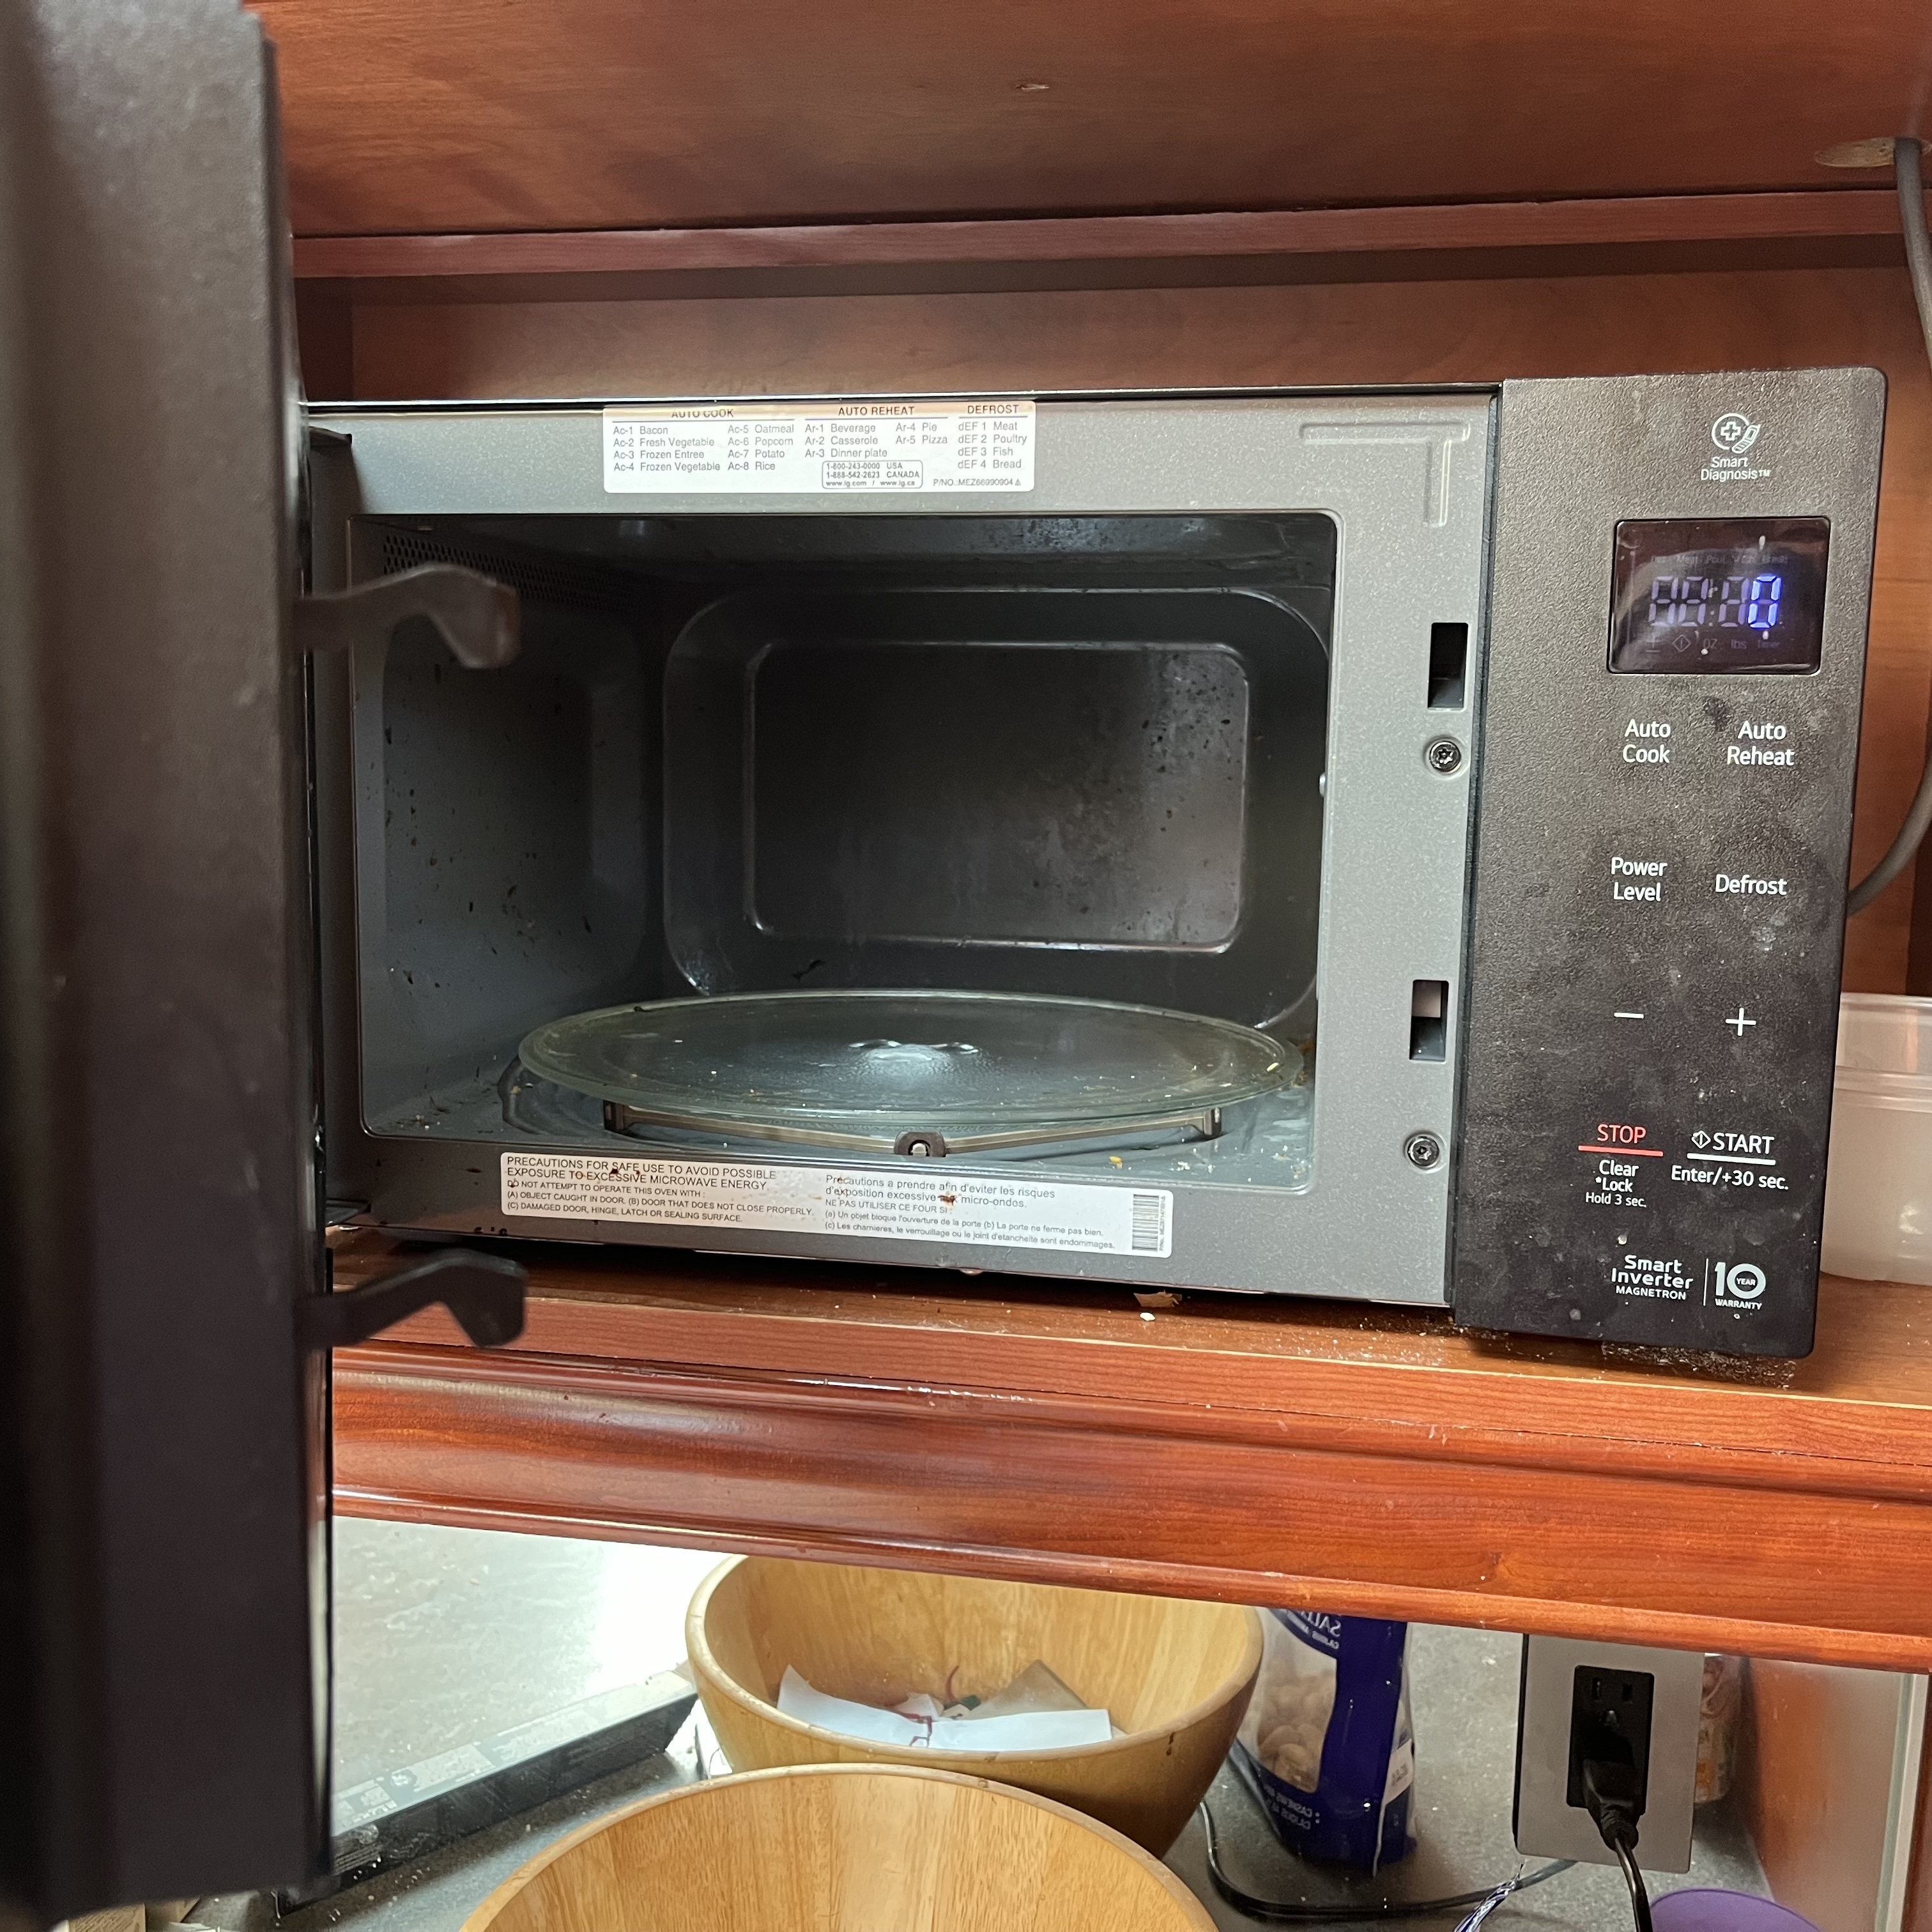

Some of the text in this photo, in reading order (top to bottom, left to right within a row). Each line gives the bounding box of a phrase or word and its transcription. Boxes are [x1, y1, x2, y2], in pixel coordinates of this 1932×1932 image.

[671, 408, 734, 418] AUTO COOK
[838, 406, 914, 416] AUTO REHEAT
[967, 404, 1019, 414] DEFROST
[613, 425, 668, 435] Ac-1 Bacon
[728, 424, 794, 434] Ac-5 Oatmeal
[805, 424, 875, 434] Ar-1 Beverage
[896, 422, 937, 432] Ar-4 Pie
[958, 422, 1017, 431] dEF 1 Meat
[613, 438, 714, 448] Ac-2 Fresh Vegetable
[728, 437, 793, 447] Ac-6 Popcorn
[805, 436, 878, 445] Ar-2 Casserole
[896, 435, 947, 444] Ar-5 Pizza
[958, 434, 1027, 445] dEF 2 Poultry
[613, 450, 704, 459] Ac-3 Frozen Entree
[728, 450, 785, 458] Ac-7 Potato
[805, 448, 887, 459] Ar-3 Dinner plate
[958, 447, 1013, 456] dEF 3 Fish
[614, 462, 720, 473] Ac-4 Frozen Vegetable
[728, 462, 775, 470] Ac-8 Rice
[958, 459, 1022, 469] dEF 4 Bread
[1712, 457, 1748, 468] Smart
[1625, 719, 1671, 739] Auto
[1738, 721, 1786, 740] Auto
[1622, 744, 1670, 763] Cook
[1727, 746, 1794, 766] Reheat
[1611, 857, 1667, 877] Power
[1715, 874, 1788, 895] Defrost
[1613, 882, 1661, 902] Level
[1597, 1124, 1646, 1144] STOP
[1712, 1133, 1775, 1154] START
[507, 1156, 776, 1179] PRECAUTIONS FOR SAFE USE TO AVOID POSSIBLE
[1599, 1160, 1639, 1177] Clear
[507, 1167, 766, 1190] EXPOSURE TO EXCESSIVE MICROWAVE ENERGY
[1671, 1165, 1789, 1190] Enter/+30 sec.
[540, 1182, 577, 1190] ATTEMPT
[594, 1184, 631, 1193] OPERATE
[826, 1175, 884, 1187] Precautions
[897, 1181, 935, 1190] prendre
[939, 1183, 957, 1192] afin
[960, 1184, 997, 1194] d'eviter
[1000, 1186, 1015, 1195] les
[1018, 1188, 1055, 1199] risques
[554, 1193, 587, 1202] CAUGHT
[825, 1186, 884, 1198] d'exposition
[887, 1192, 936, 1201] excessive
[961, 1196, 1027, 1208] micro-ondes.
[1586, 1192, 1646, 1208] Hold 3 sec.
[508, 1202, 519, 1210] (C)
[521, 1203, 560, 1211] DAMAGED
[621, 1208, 647, 1216] LATCH
[664, 1211, 699, 1220] SEALING
[859, 1202, 896, 1210] UTILISER
[850, 1213, 869, 1221] objet
[871, 1213, 896, 1222] bloque
[962, 1221, 981, 1229] porte
[1043, 1225, 1066, 1234] ferme
[973, 1232, 989, 1240] joint
[1624, 1255, 1682, 1274] Smart
[1611, 1268, 1693, 1289] Inverter
[1715, 1262, 1766, 1300] 10
[1736, 1278, 1756, 1286] YEAR
[1616, 1285, 1686, 1300] MAGNETRON
[1715, 1298, 1762, 1310] WARRANTY
